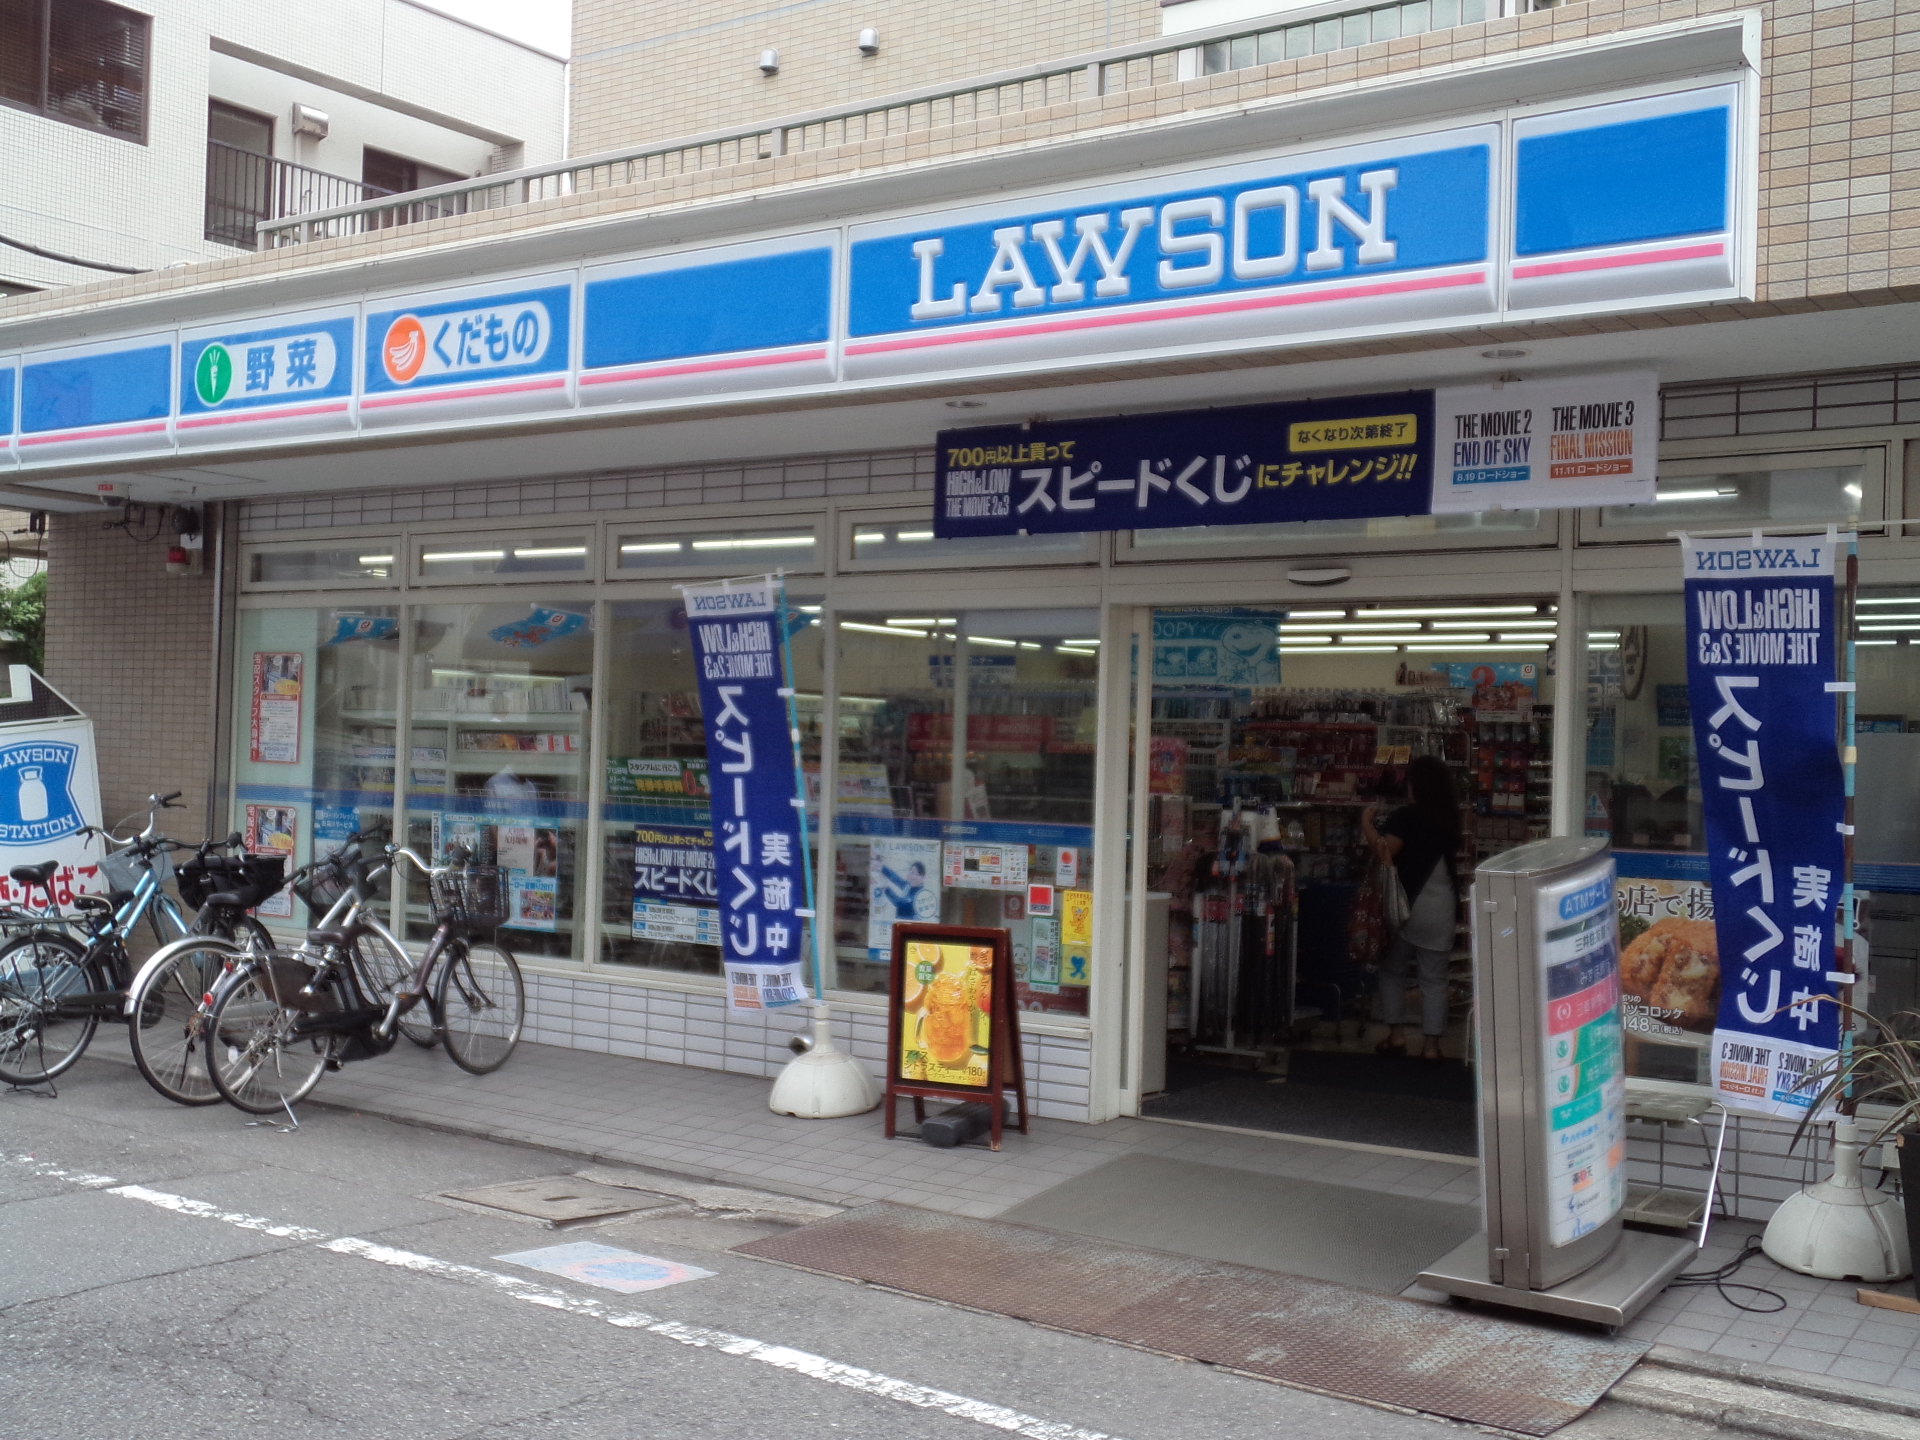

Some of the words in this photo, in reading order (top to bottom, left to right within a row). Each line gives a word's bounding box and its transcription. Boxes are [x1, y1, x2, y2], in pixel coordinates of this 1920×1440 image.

[911, 168, 1398, 321] LAWSON
[432, 308, 540, 369] くだもの
[245, 338, 318, 393] 野菜
[1455, 414, 1478, 440] THE
[1480, 410, 1522, 438] MOVIE
[1524, 409, 1533, 434] 2
[1552, 405, 1577, 432] THE
[1579, 402, 1623, 430] MOVIE
[1625, 400, 1635, 427] 3
[1298, 421, 1409, 444] なくなり次第終了
[1550, 433, 1583, 461] FINAL
[1584, 429, 1633, 460] MISSION
[948, 440, 1077, 468] 700円以上買って
[1453, 441, 1481, 468] END
[1484, 439, 1502, 466] OF
[1503, 437, 1532, 464] SKY
[1017, 454, 1253, 515] スピードくじ
[1457, 473, 1476, 482] 8.19
[1478, 470, 1527, 481] ロードショー
[1554, 467, 1575, 476] 11.11
[1577, 463, 1630, 474] ロードショー
[946, 497, 962, 517] THE
[963, 496, 991, 517] MOVIE
[634, 865, 719, 897] スピードくじ
